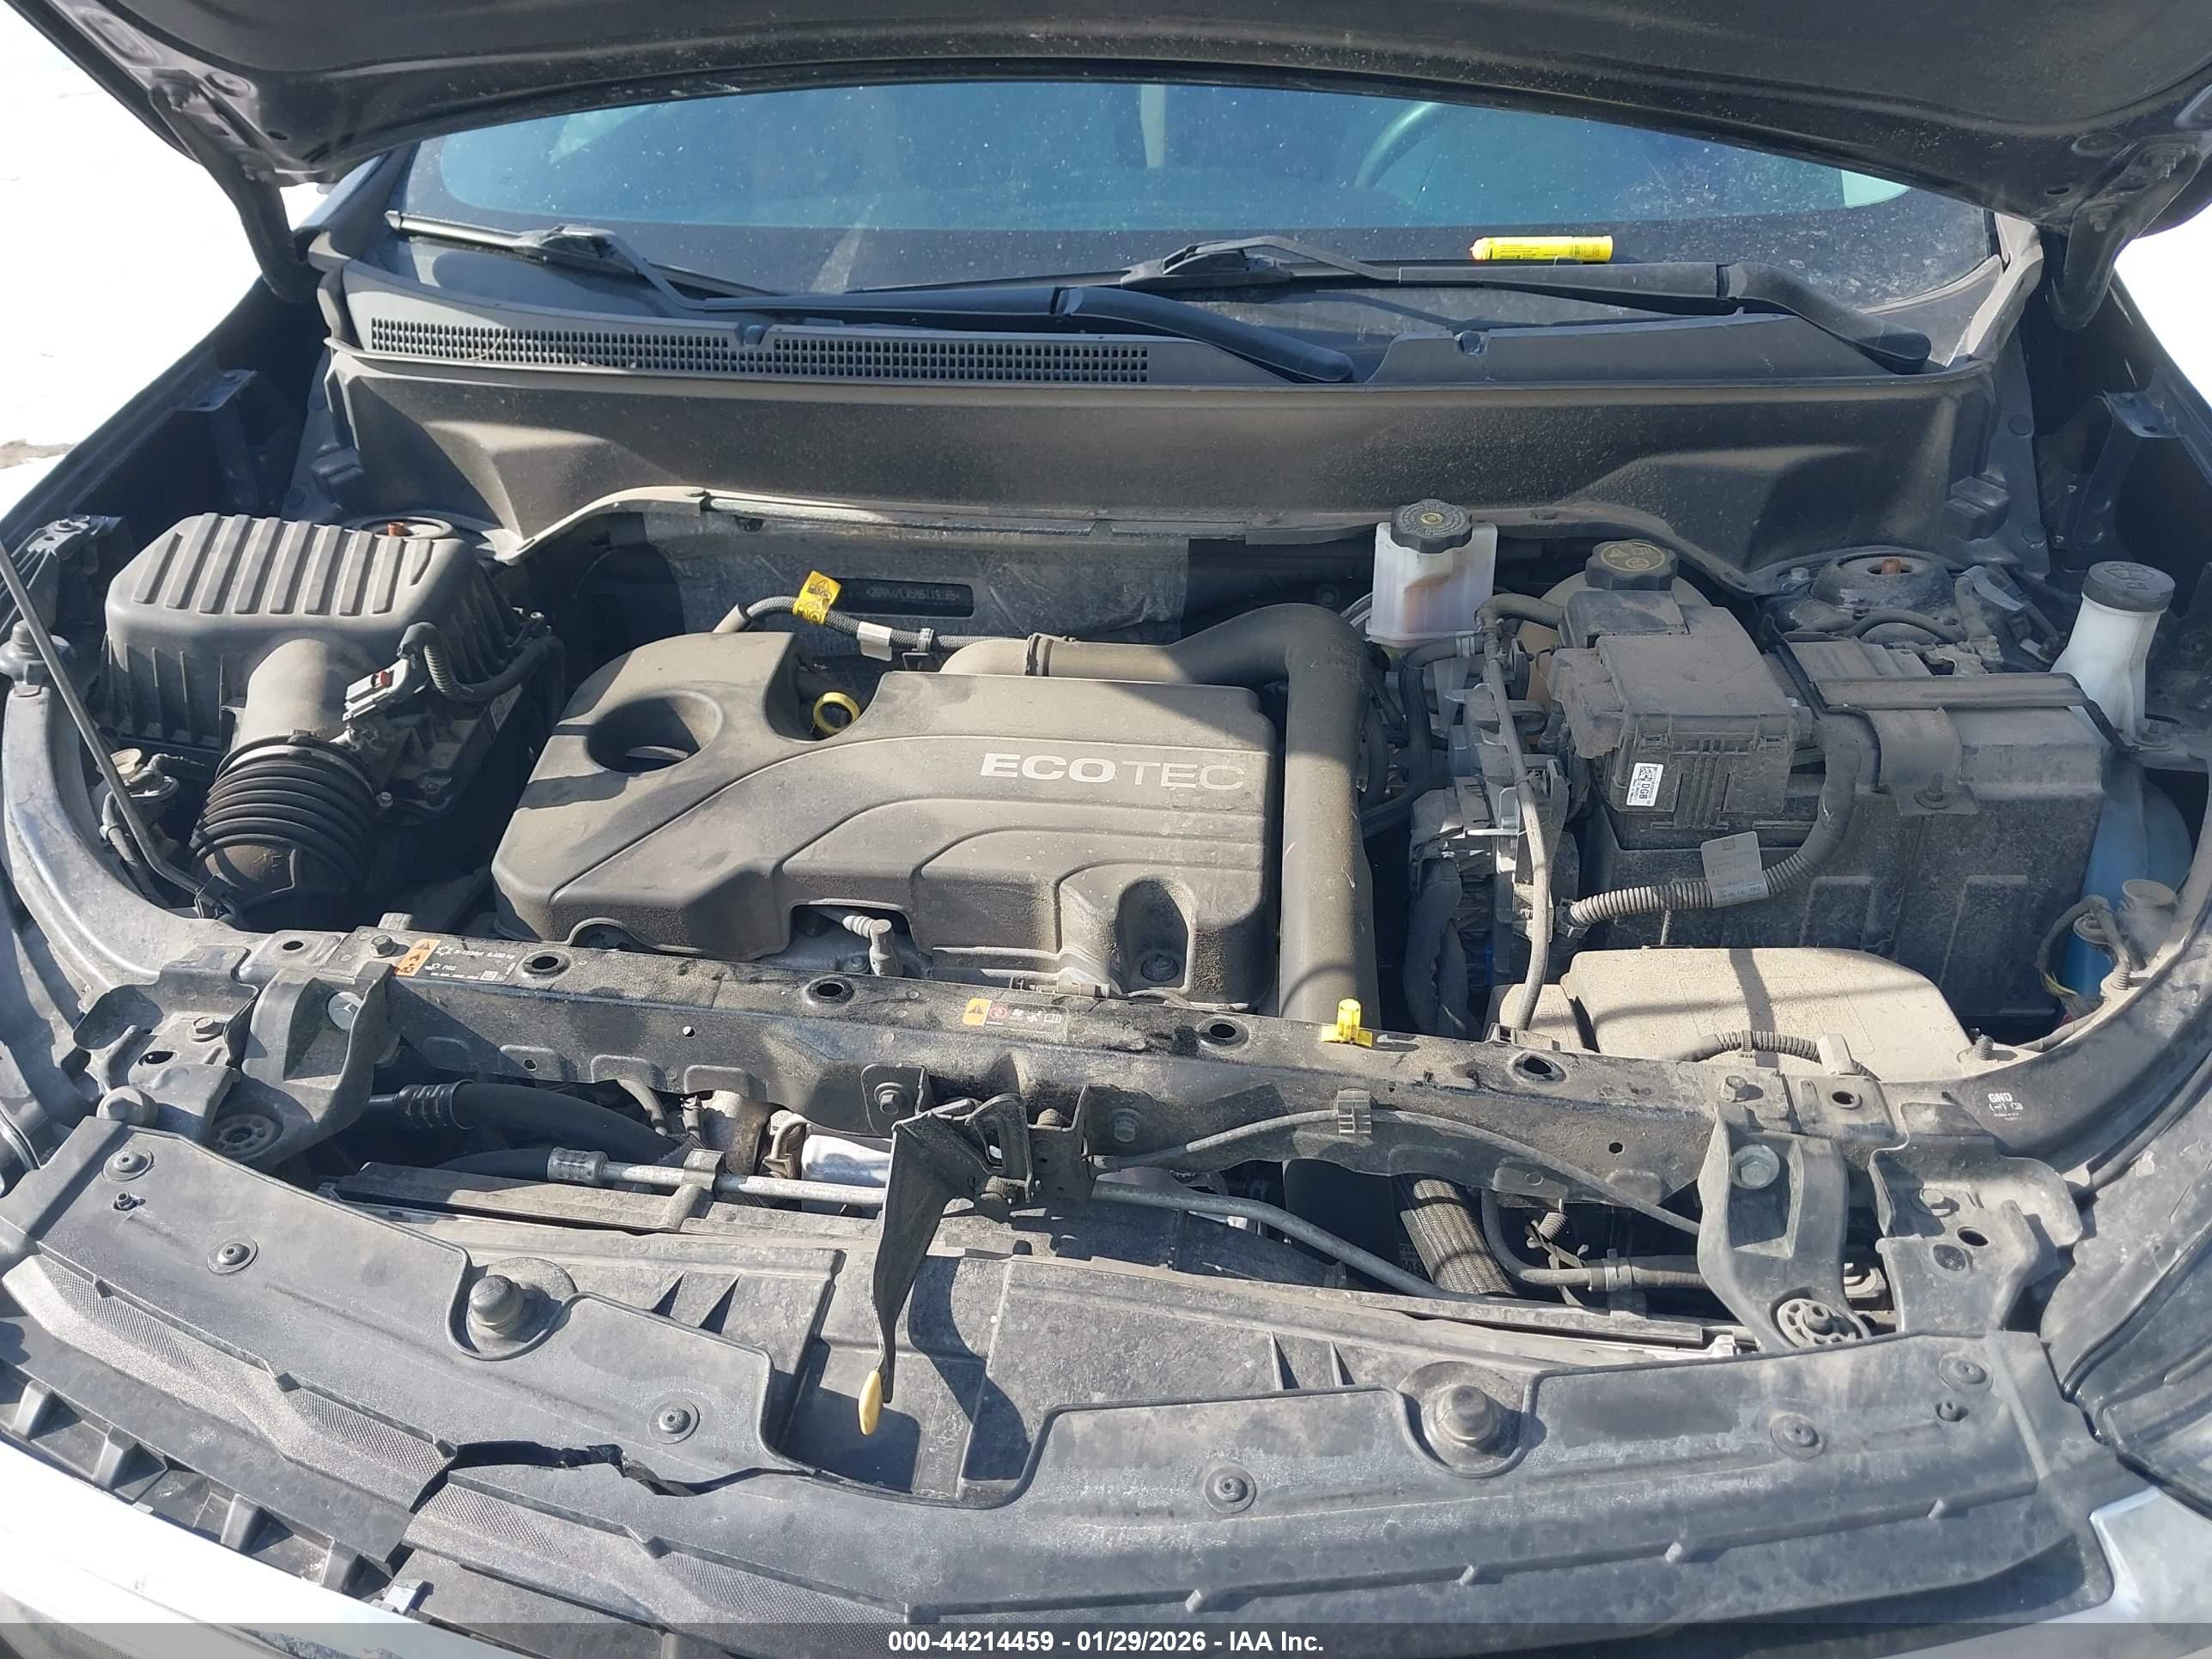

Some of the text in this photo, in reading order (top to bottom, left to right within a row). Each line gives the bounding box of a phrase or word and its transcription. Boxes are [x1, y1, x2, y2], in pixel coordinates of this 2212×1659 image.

[980, 753, 1245, 790] ECOTEC
[1638, 783, 1650, 799] DGB
[1988, 1092, 2013, 1103] GND
